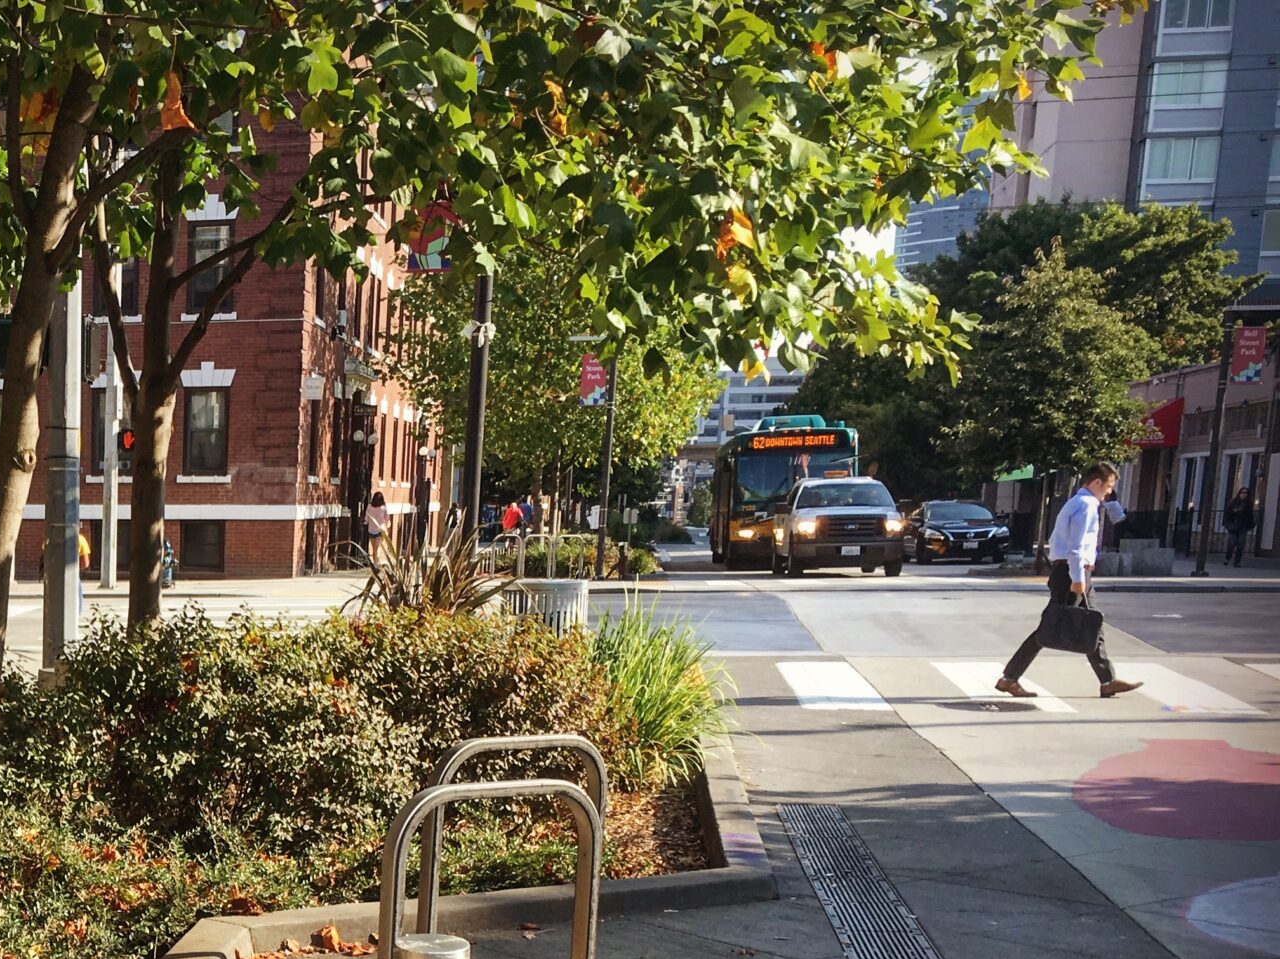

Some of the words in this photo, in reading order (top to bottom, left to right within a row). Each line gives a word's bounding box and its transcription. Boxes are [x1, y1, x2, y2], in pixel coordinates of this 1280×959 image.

[753, 437, 765, 449] 62
[765, 436, 803, 447] DOWNTOWN
[804, 434, 835, 445] SEATTLE
